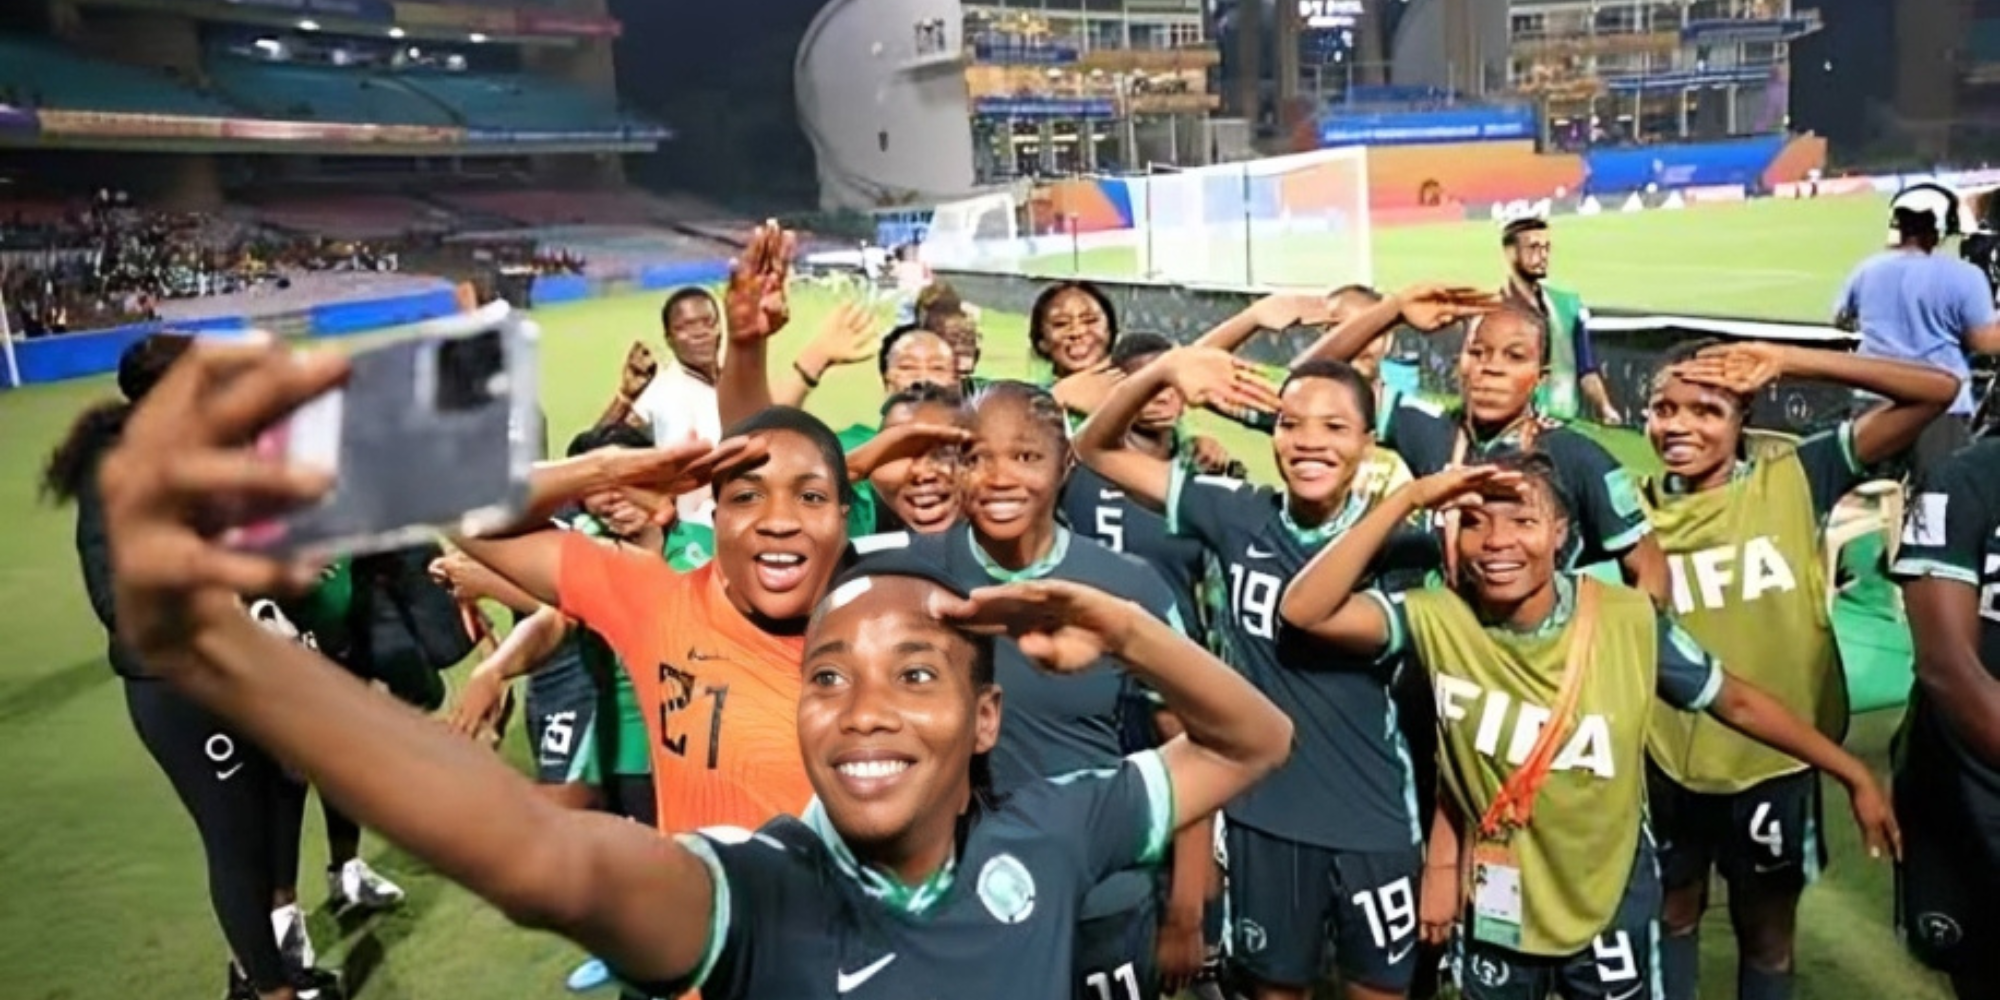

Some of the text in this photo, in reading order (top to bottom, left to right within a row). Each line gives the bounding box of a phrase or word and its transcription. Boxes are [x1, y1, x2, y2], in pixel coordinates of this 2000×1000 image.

[1096, 505, 1123, 553] 5
[1230, 562, 1282, 639] 19
[1667, 535, 1796, 615] IFA
[1749, 801, 1783, 857] 4
[1352, 876, 1416, 948] 19
